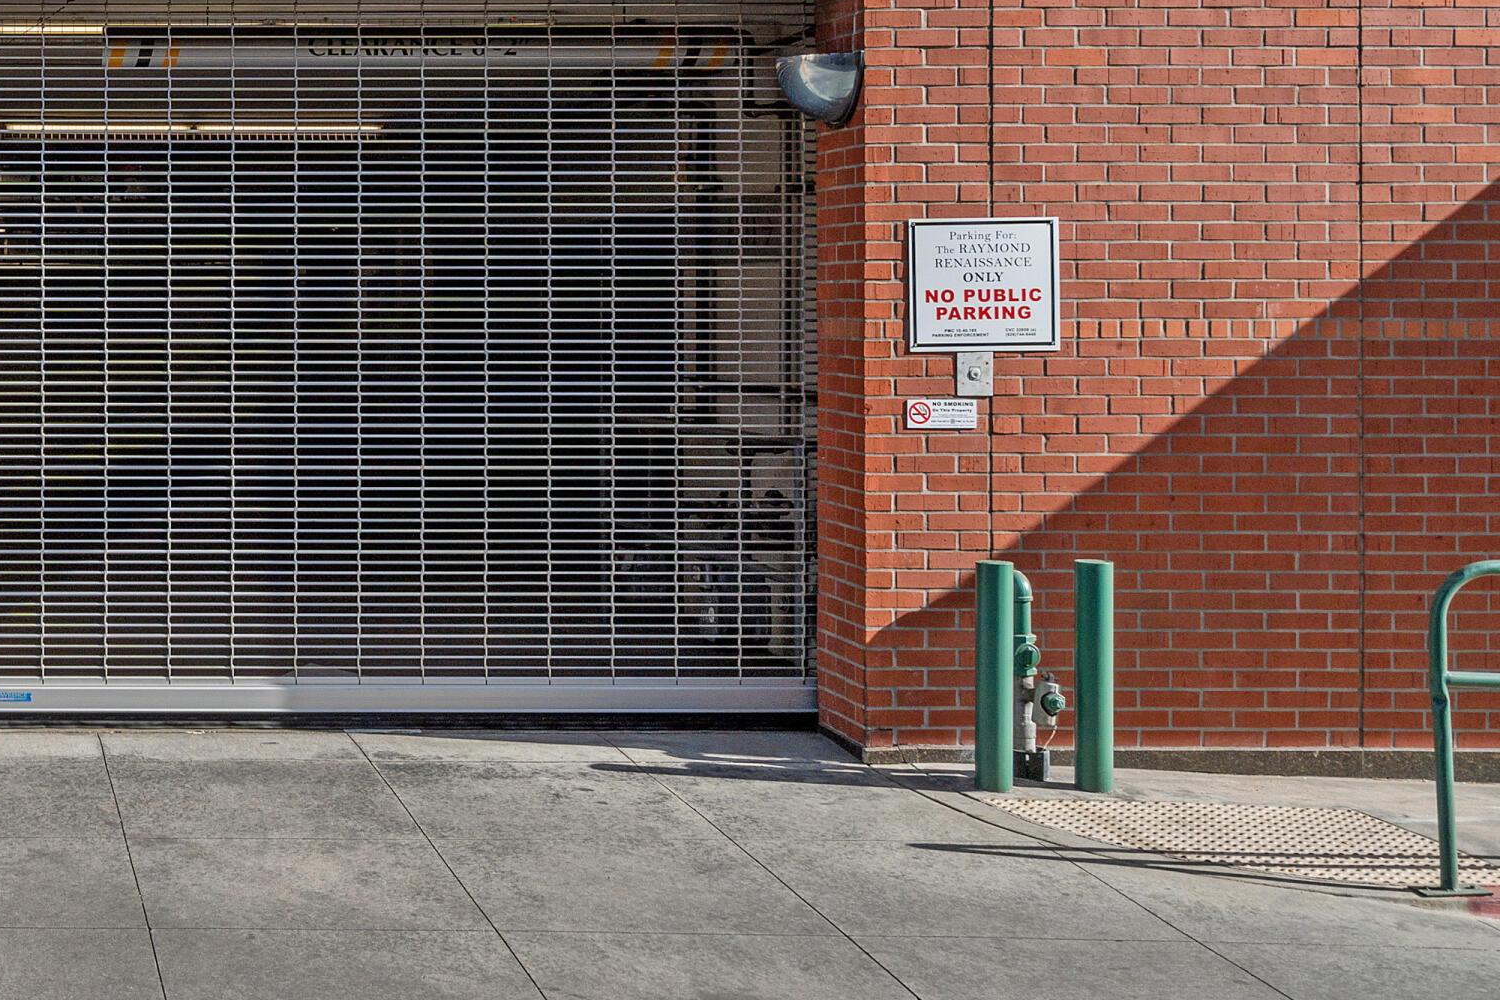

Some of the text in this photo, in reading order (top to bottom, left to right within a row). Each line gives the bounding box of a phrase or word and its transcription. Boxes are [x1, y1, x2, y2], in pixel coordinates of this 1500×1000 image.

[307, 37, 462, 56] CLEARANCE
[949, 230, 1017, 242] Parking For:
[935, 243, 1031, 255] The RAYMOND
[935, 257, 1032, 268] RENAISSANCE
[963, 272, 1004, 283] ONLY
[925, 288, 1042, 303] NO PUBLIC
[936, 305, 1032, 320] PARKING
